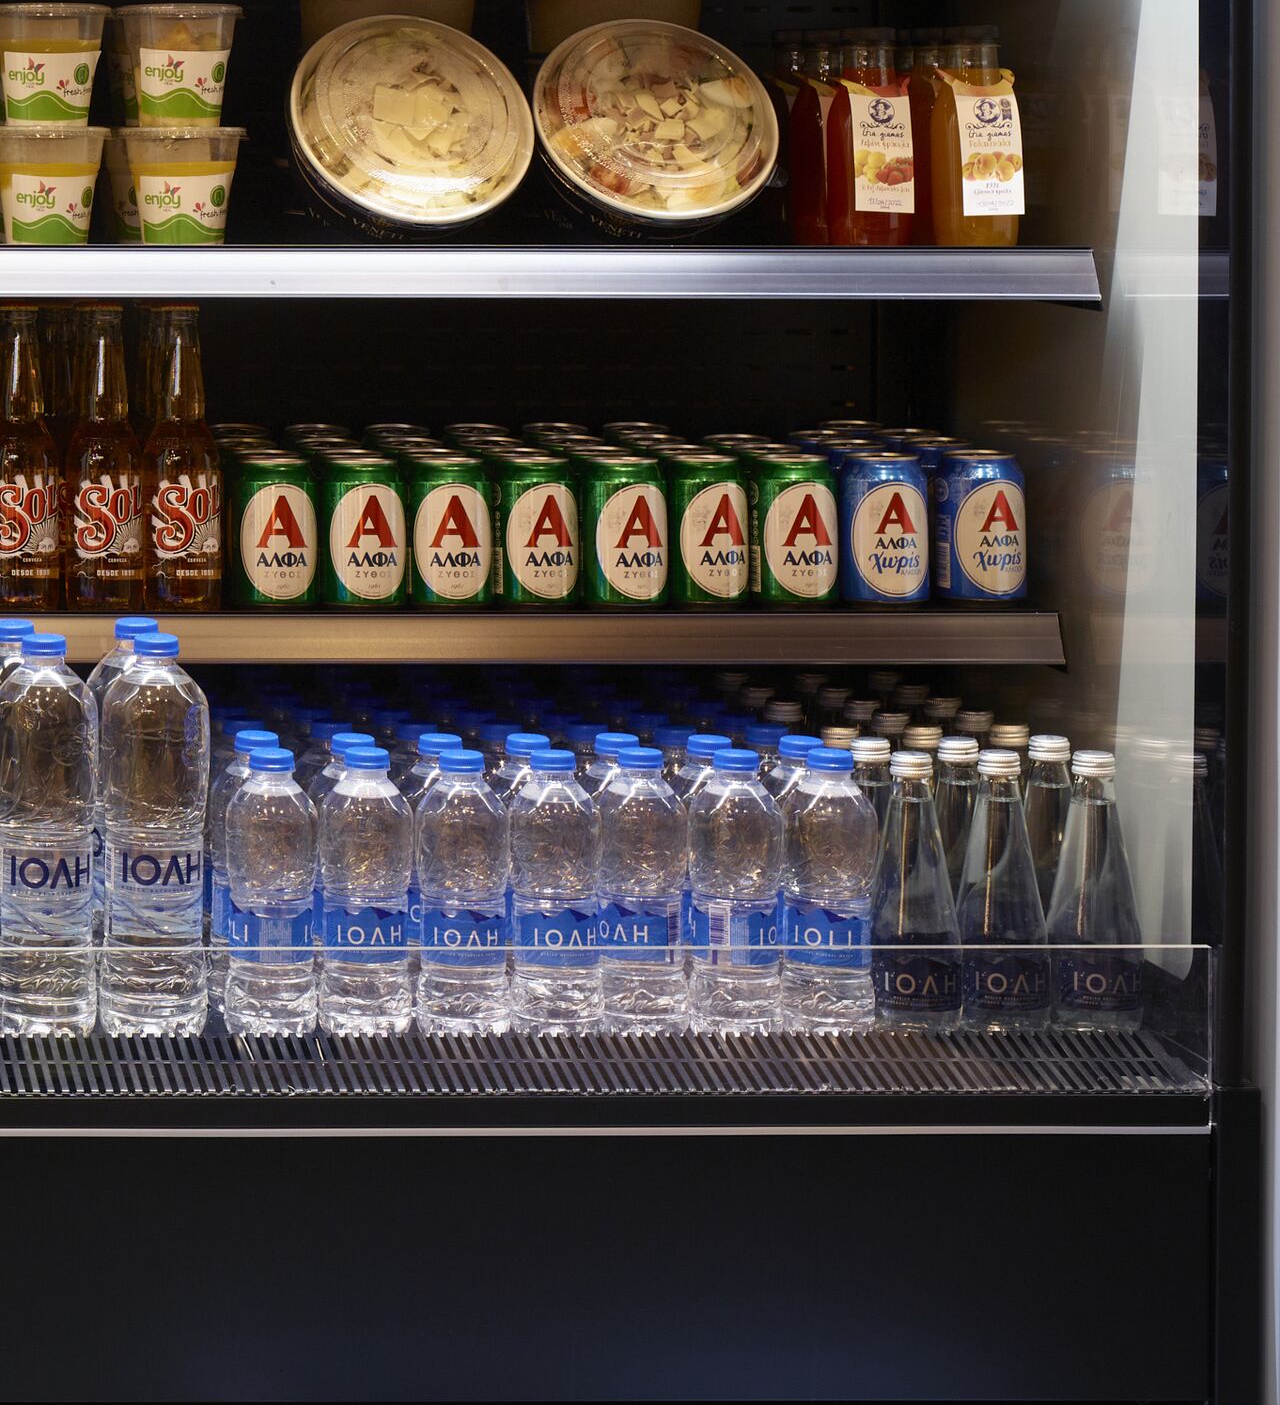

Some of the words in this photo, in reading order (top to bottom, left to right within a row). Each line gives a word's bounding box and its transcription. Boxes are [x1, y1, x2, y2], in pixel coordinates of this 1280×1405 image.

[9, 68, 46, 86] enjoy
[144, 64, 184, 83] enjoy
[16, 190, 56, 209] enjoy
